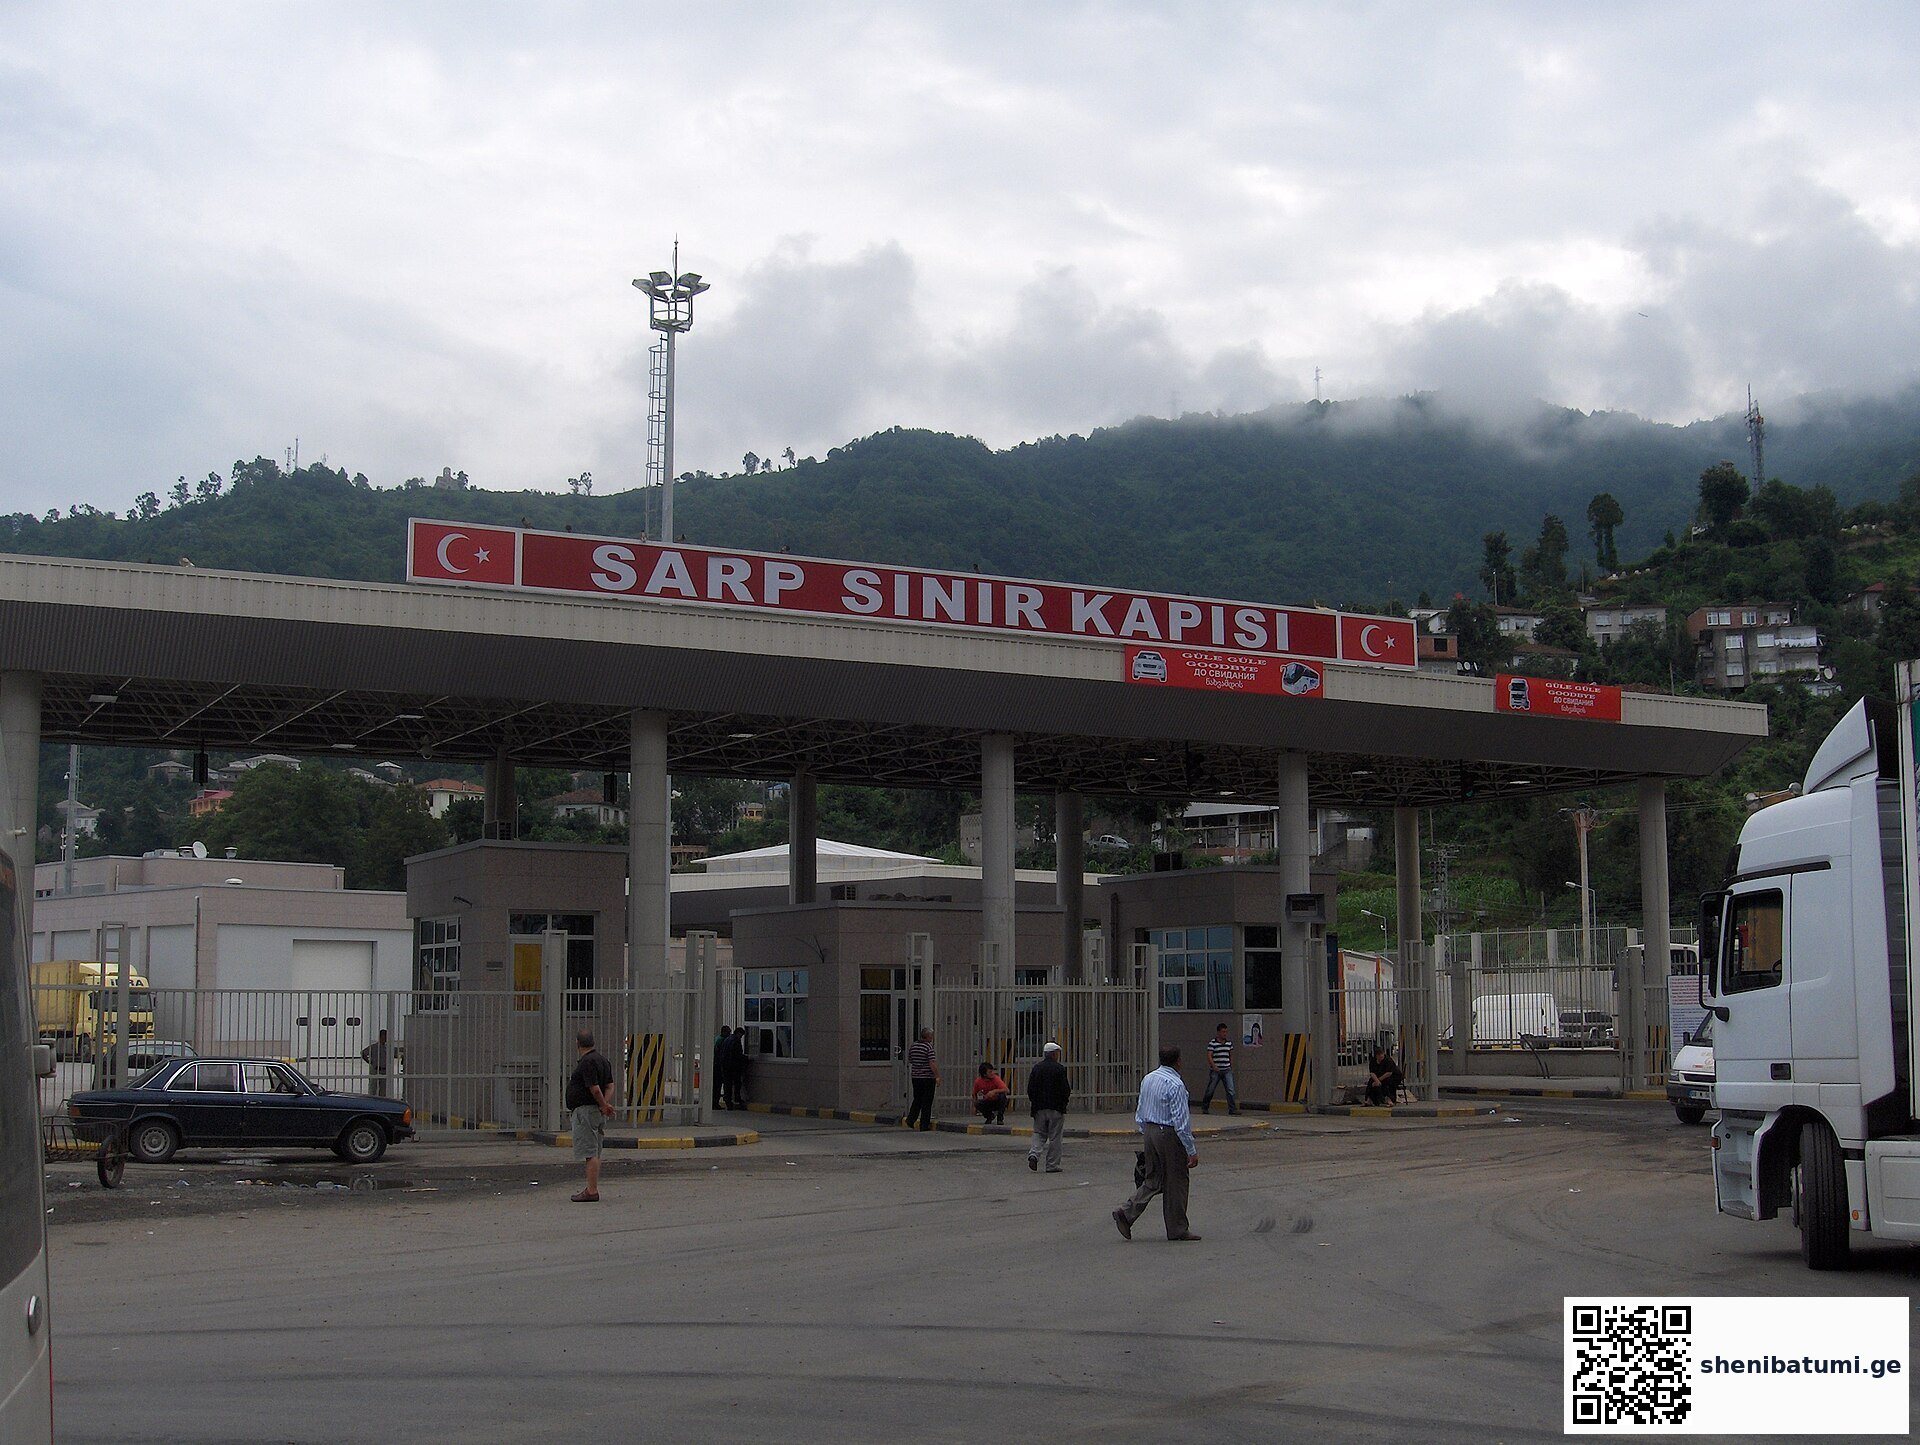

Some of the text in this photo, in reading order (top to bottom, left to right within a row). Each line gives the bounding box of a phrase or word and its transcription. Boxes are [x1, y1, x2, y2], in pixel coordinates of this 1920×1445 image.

[590, 544, 1290, 652] SARP SINIR KAPISI
[1181, 652, 1267, 667] GÜLE GÜLE
[1185, 660, 1259, 673] GOODBYE
[1193, 668, 1256, 681] ДО СВИДАНИЯ
[1548, 689, 1596, 700] GOODBYE
